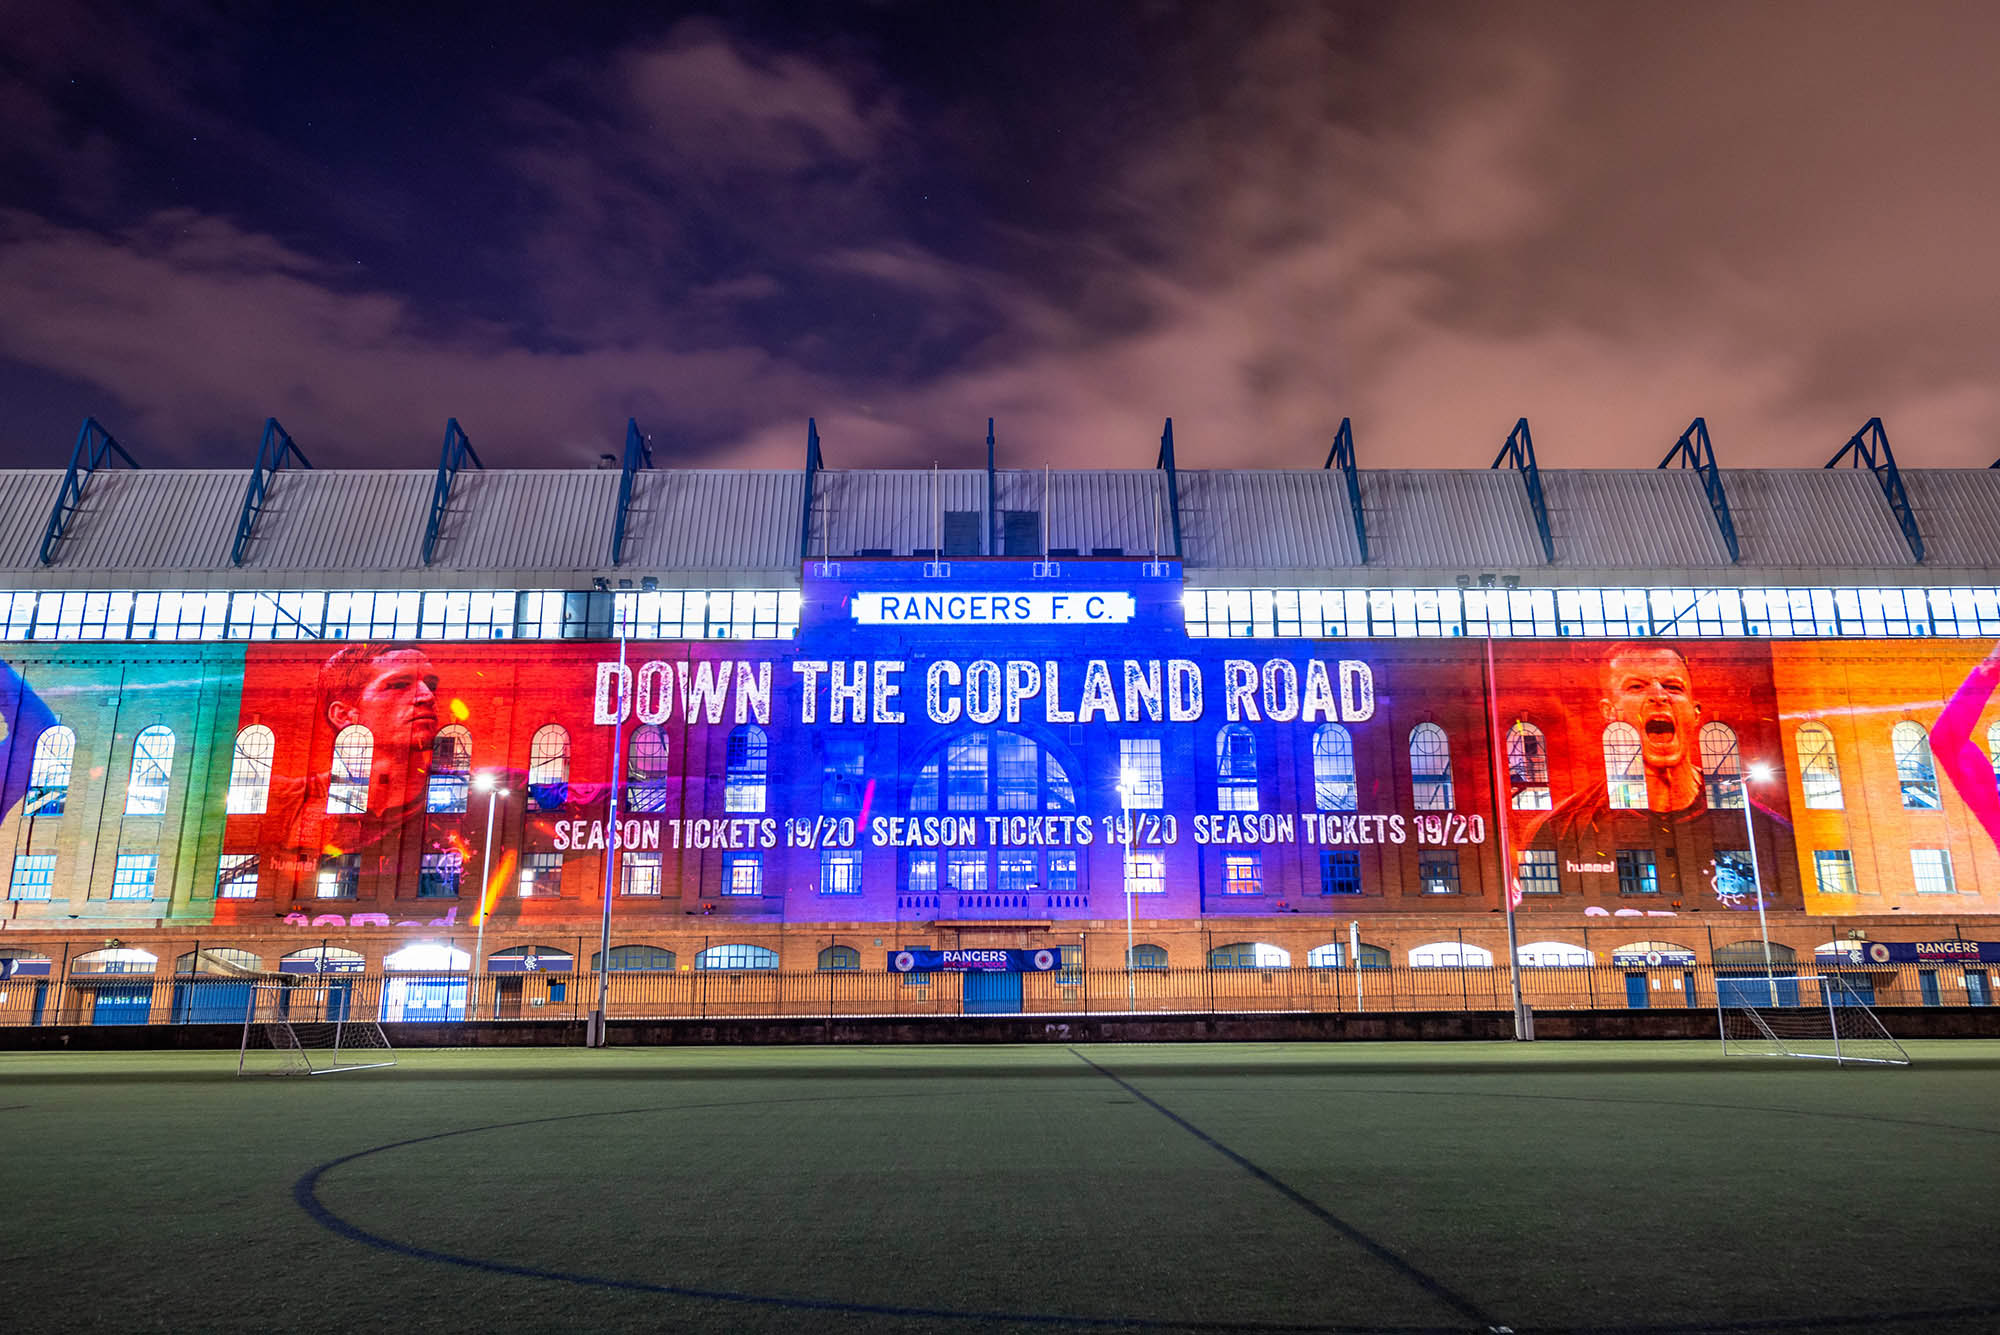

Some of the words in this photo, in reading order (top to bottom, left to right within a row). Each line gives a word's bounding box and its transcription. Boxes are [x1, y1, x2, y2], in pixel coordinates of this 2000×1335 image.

[880, 596, 1031, 620] RANGERS
[1051, 596, 1071, 620] F.
[1085, 596, 1113, 620] C.
[593, 660, 772, 725] DOWN
[792, 660, 905, 724] THE
[926, 659, 1204, 724] COPLAND
[1224, 658, 1375, 723] ROAD
[553, 819, 660, 850] SEASON
[669, 818, 777, 849] TICKETS
[785, 815, 856, 850] 19/20
[872, 816, 976, 846] SEASON
[985, 815, 1093, 845] TICKETS
[1102, 812, 1178, 845] 19/20
[1193, 814, 1295, 844] SEASON
[1302, 813, 1407, 844] TICKETS
[1413, 812, 1486, 846] 19/20
[269, 857, 318, 873] hummel
[1566, 859, 1615, 873] hummel
[943, 950, 1007, 962] RANGERS
[1916, 942, 1980, 954] RANGERS
